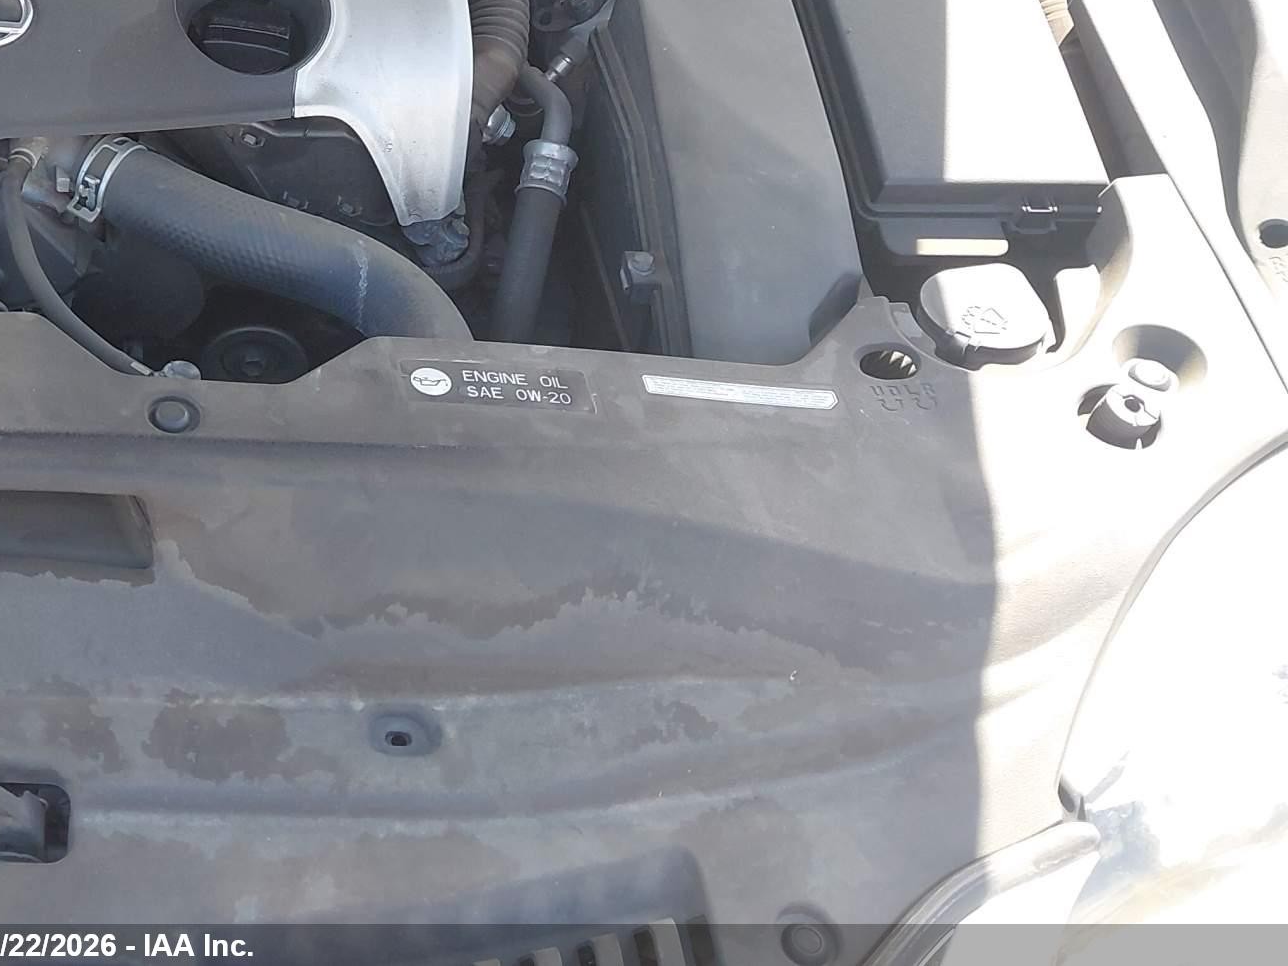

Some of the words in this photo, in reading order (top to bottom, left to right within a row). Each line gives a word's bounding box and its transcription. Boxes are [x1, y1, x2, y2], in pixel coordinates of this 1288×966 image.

[462, 369, 528, 386] ENGINE
[539, 375, 569, 389] OIL
[466, 385, 505, 399] SAE
[515, 389, 572, 405] 0W-20
